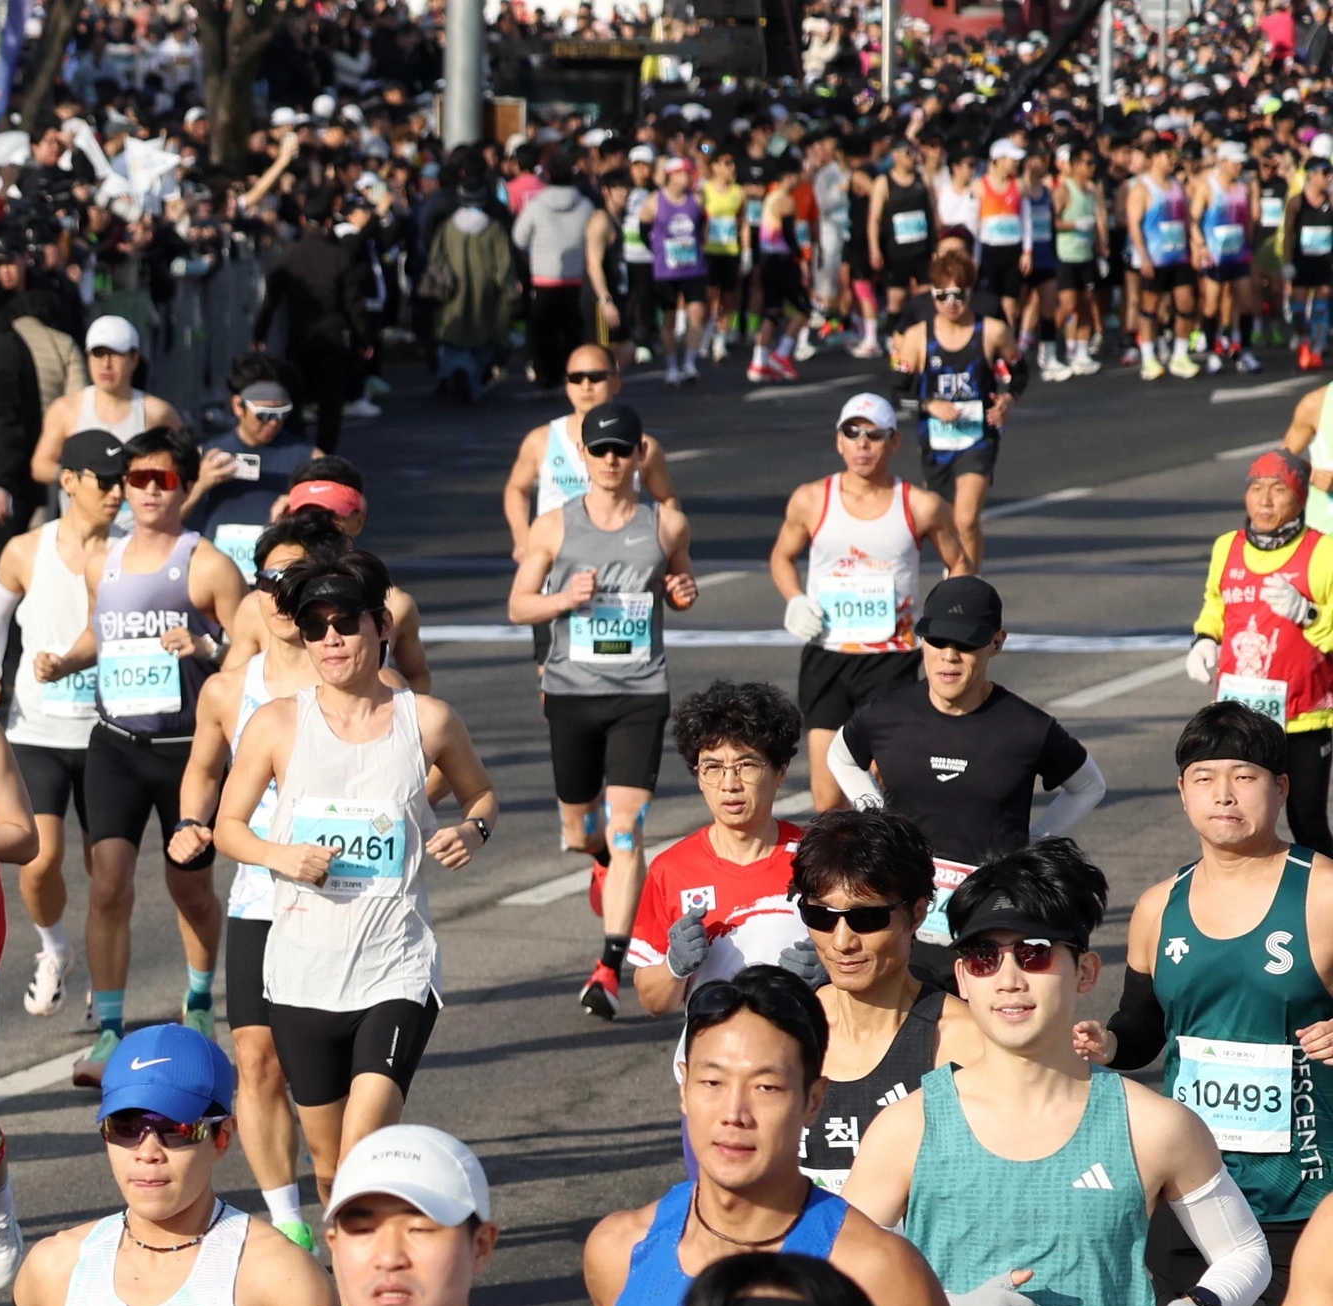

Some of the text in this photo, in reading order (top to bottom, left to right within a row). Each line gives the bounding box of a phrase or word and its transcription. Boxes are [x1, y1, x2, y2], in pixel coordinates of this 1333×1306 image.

[834, 600, 888, 618] 10183
[587, 618, 648, 637] 10409
[113, 665, 173, 688] 10557
[1222, 1049, 1256, 1059] 대구광역시
[1177, 1079, 1282, 1113] S 10493
[1292, 1043, 1324, 1182] DESCENTE
[798, 1116, 860, 1158] 척
[372, 1149, 422, 1163] KIPRUN
